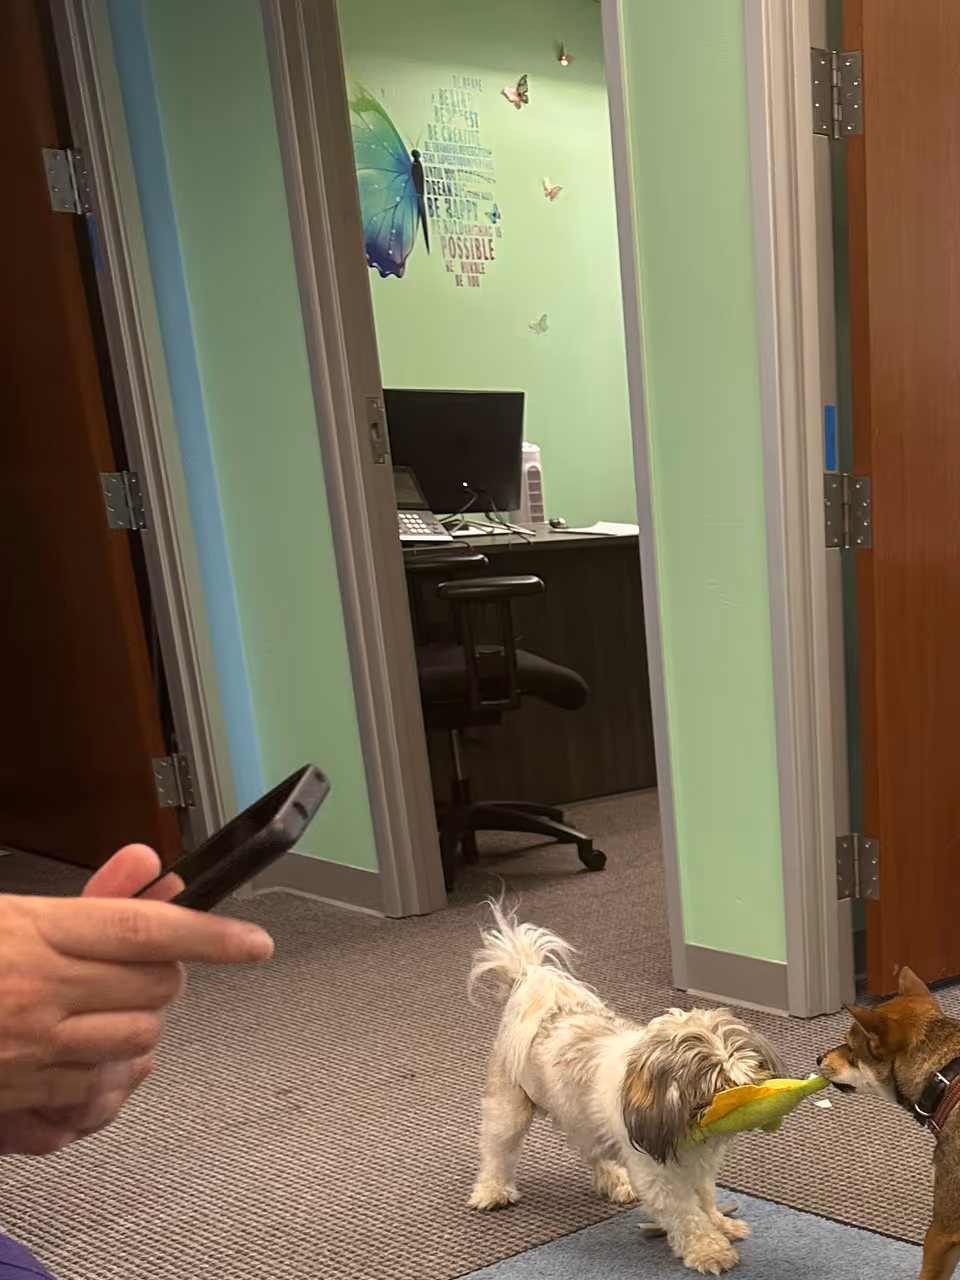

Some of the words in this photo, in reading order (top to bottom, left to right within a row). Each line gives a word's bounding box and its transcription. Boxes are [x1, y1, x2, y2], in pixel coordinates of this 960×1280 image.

[427, 197, 441, 218] BE
[444, 198, 478, 221] HAPPY
[440, 236, 496, 261] POSSIBLE
